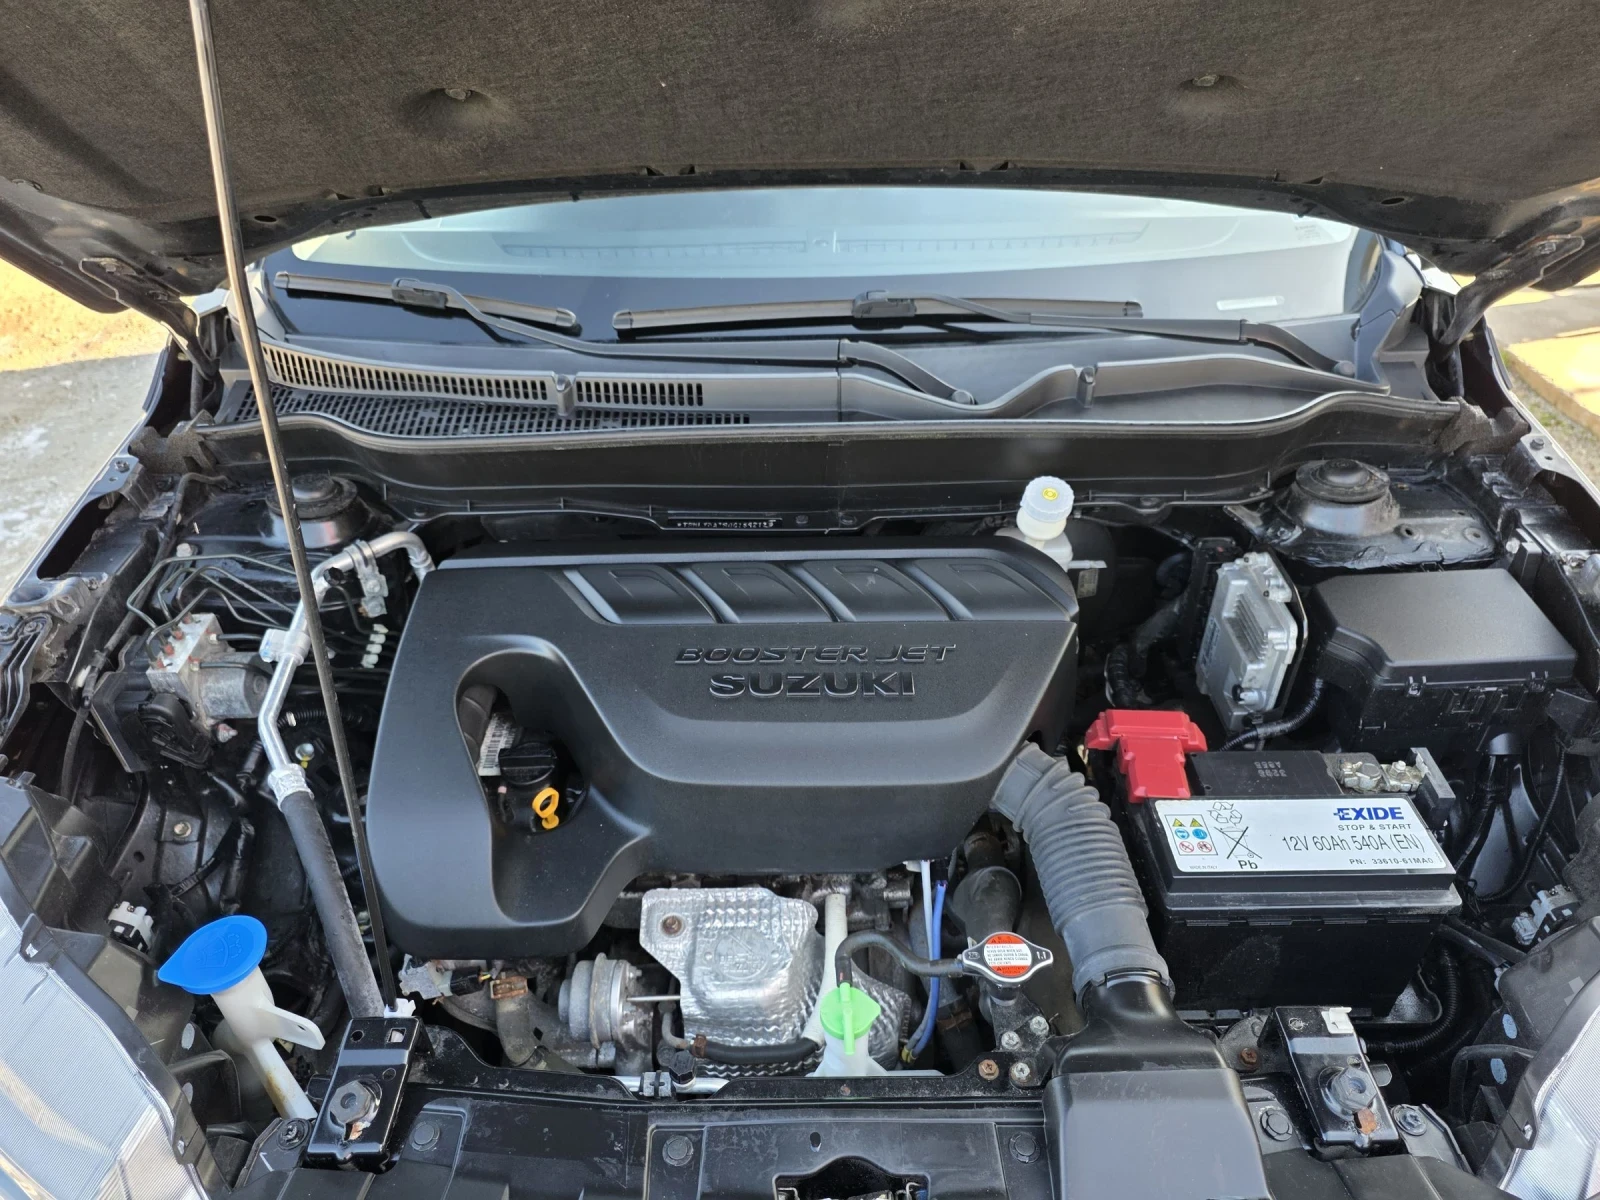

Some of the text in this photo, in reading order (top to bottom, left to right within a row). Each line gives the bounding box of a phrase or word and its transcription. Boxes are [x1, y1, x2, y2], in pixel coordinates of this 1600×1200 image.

[675, 644, 957, 664] BOOSTER JET
[709, 671, 916, 697] SUZUKI
[1334, 807, 1405, 821] EXIDE
[1282, 833, 1425, 853] 12V 60Ah 540A (EN)
[1238, 859, 1258, 870] Pb
